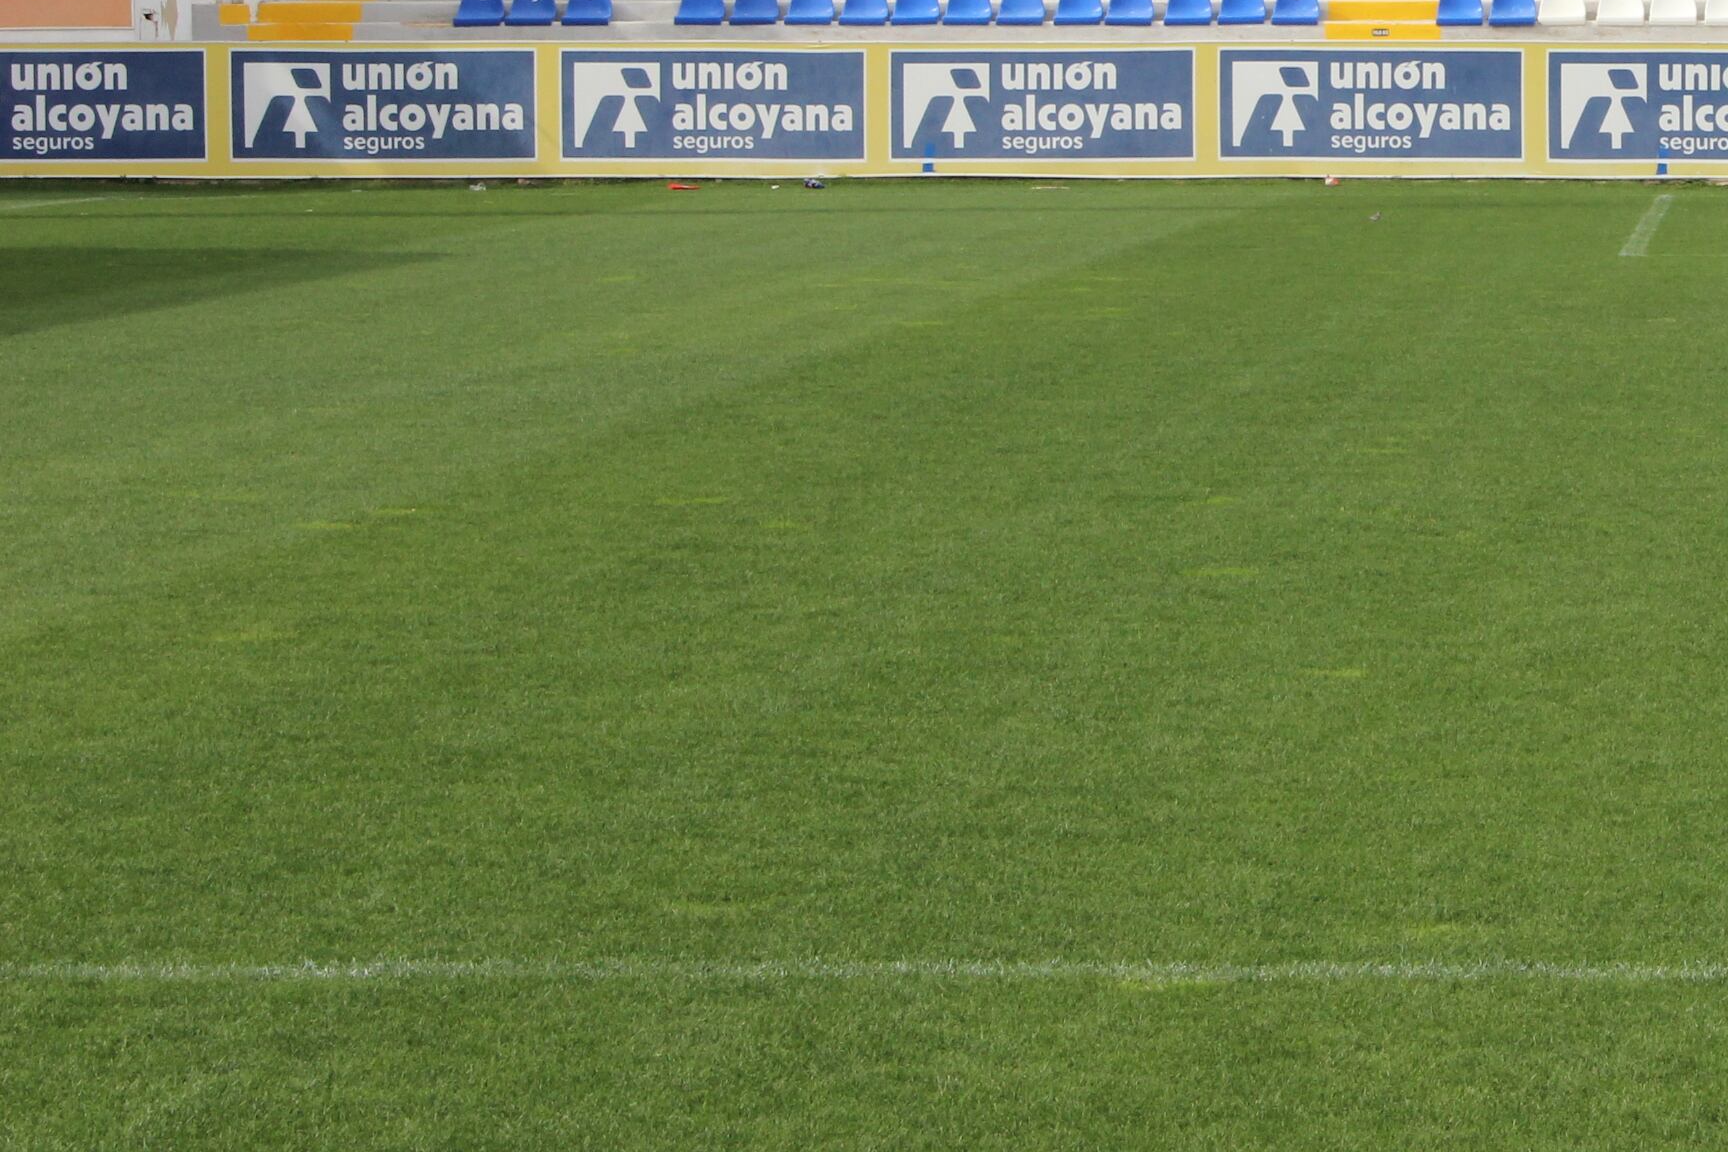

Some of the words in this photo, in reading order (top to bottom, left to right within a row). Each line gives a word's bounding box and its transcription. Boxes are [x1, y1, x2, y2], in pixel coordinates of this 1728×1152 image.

[12, 94, 193, 138] alcoyana
[343, 94, 524, 138] alcoyana
[672, 94, 853, 138] alcoyana
[1001, 94, 1182, 138] alcoyana
[1330, 94, 1511, 138] alcoyana
[12, 135, 94, 153] seguros
[343, 135, 425, 153] seguros
[672, 135, 754, 153] seguros
[1001, 135, 1083, 153] seguros
[1330, 135, 1412, 153] seguros
